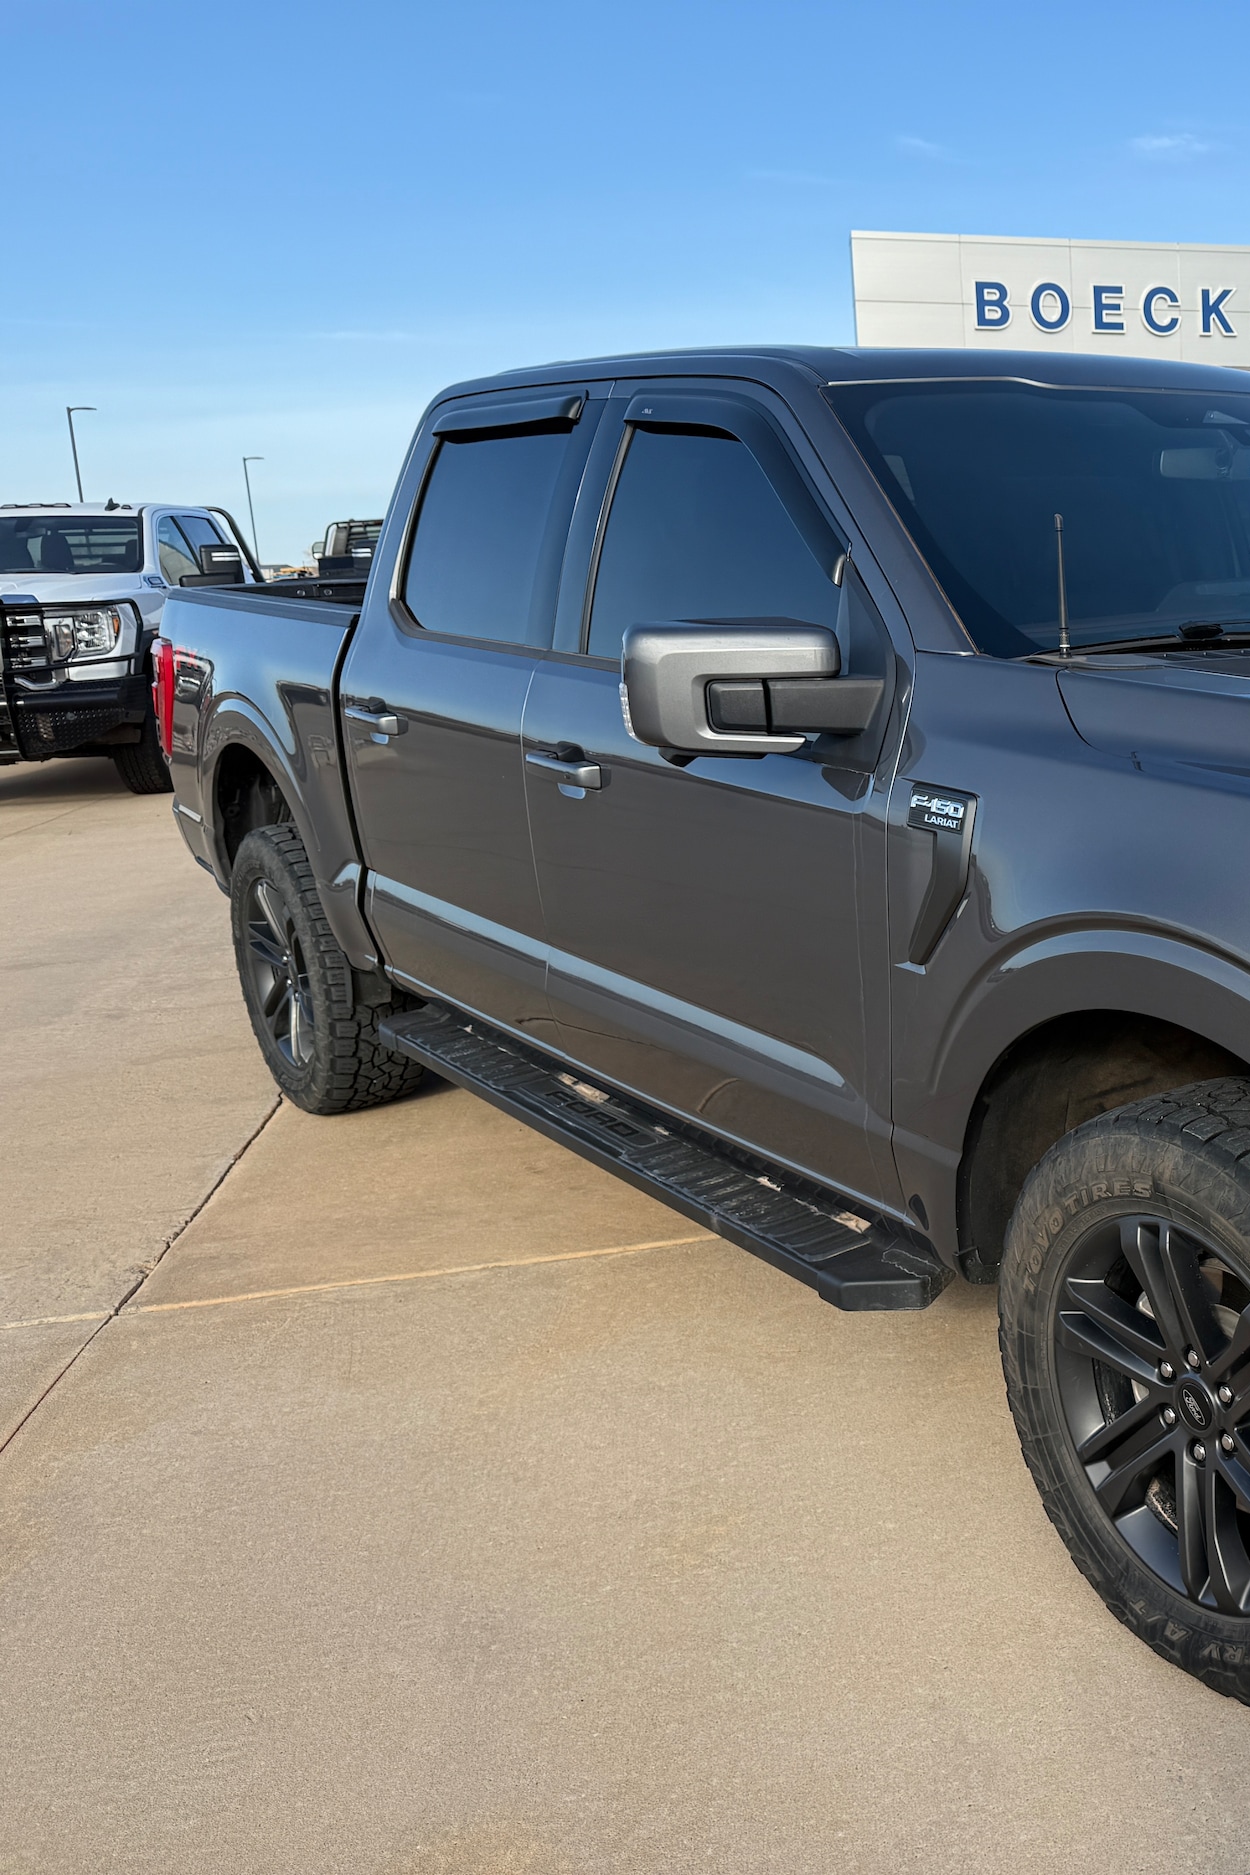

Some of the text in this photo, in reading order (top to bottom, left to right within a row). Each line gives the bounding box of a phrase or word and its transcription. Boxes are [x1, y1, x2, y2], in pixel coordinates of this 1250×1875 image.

[910, 795, 964, 818] F-150
[924, 814, 959, 828] LARIAT
[545, 1091, 640, 1137] FORD
[1022, 1206, 1065, 1295] TOYO
[1063, 1179, 1154, 1216] TIRES
